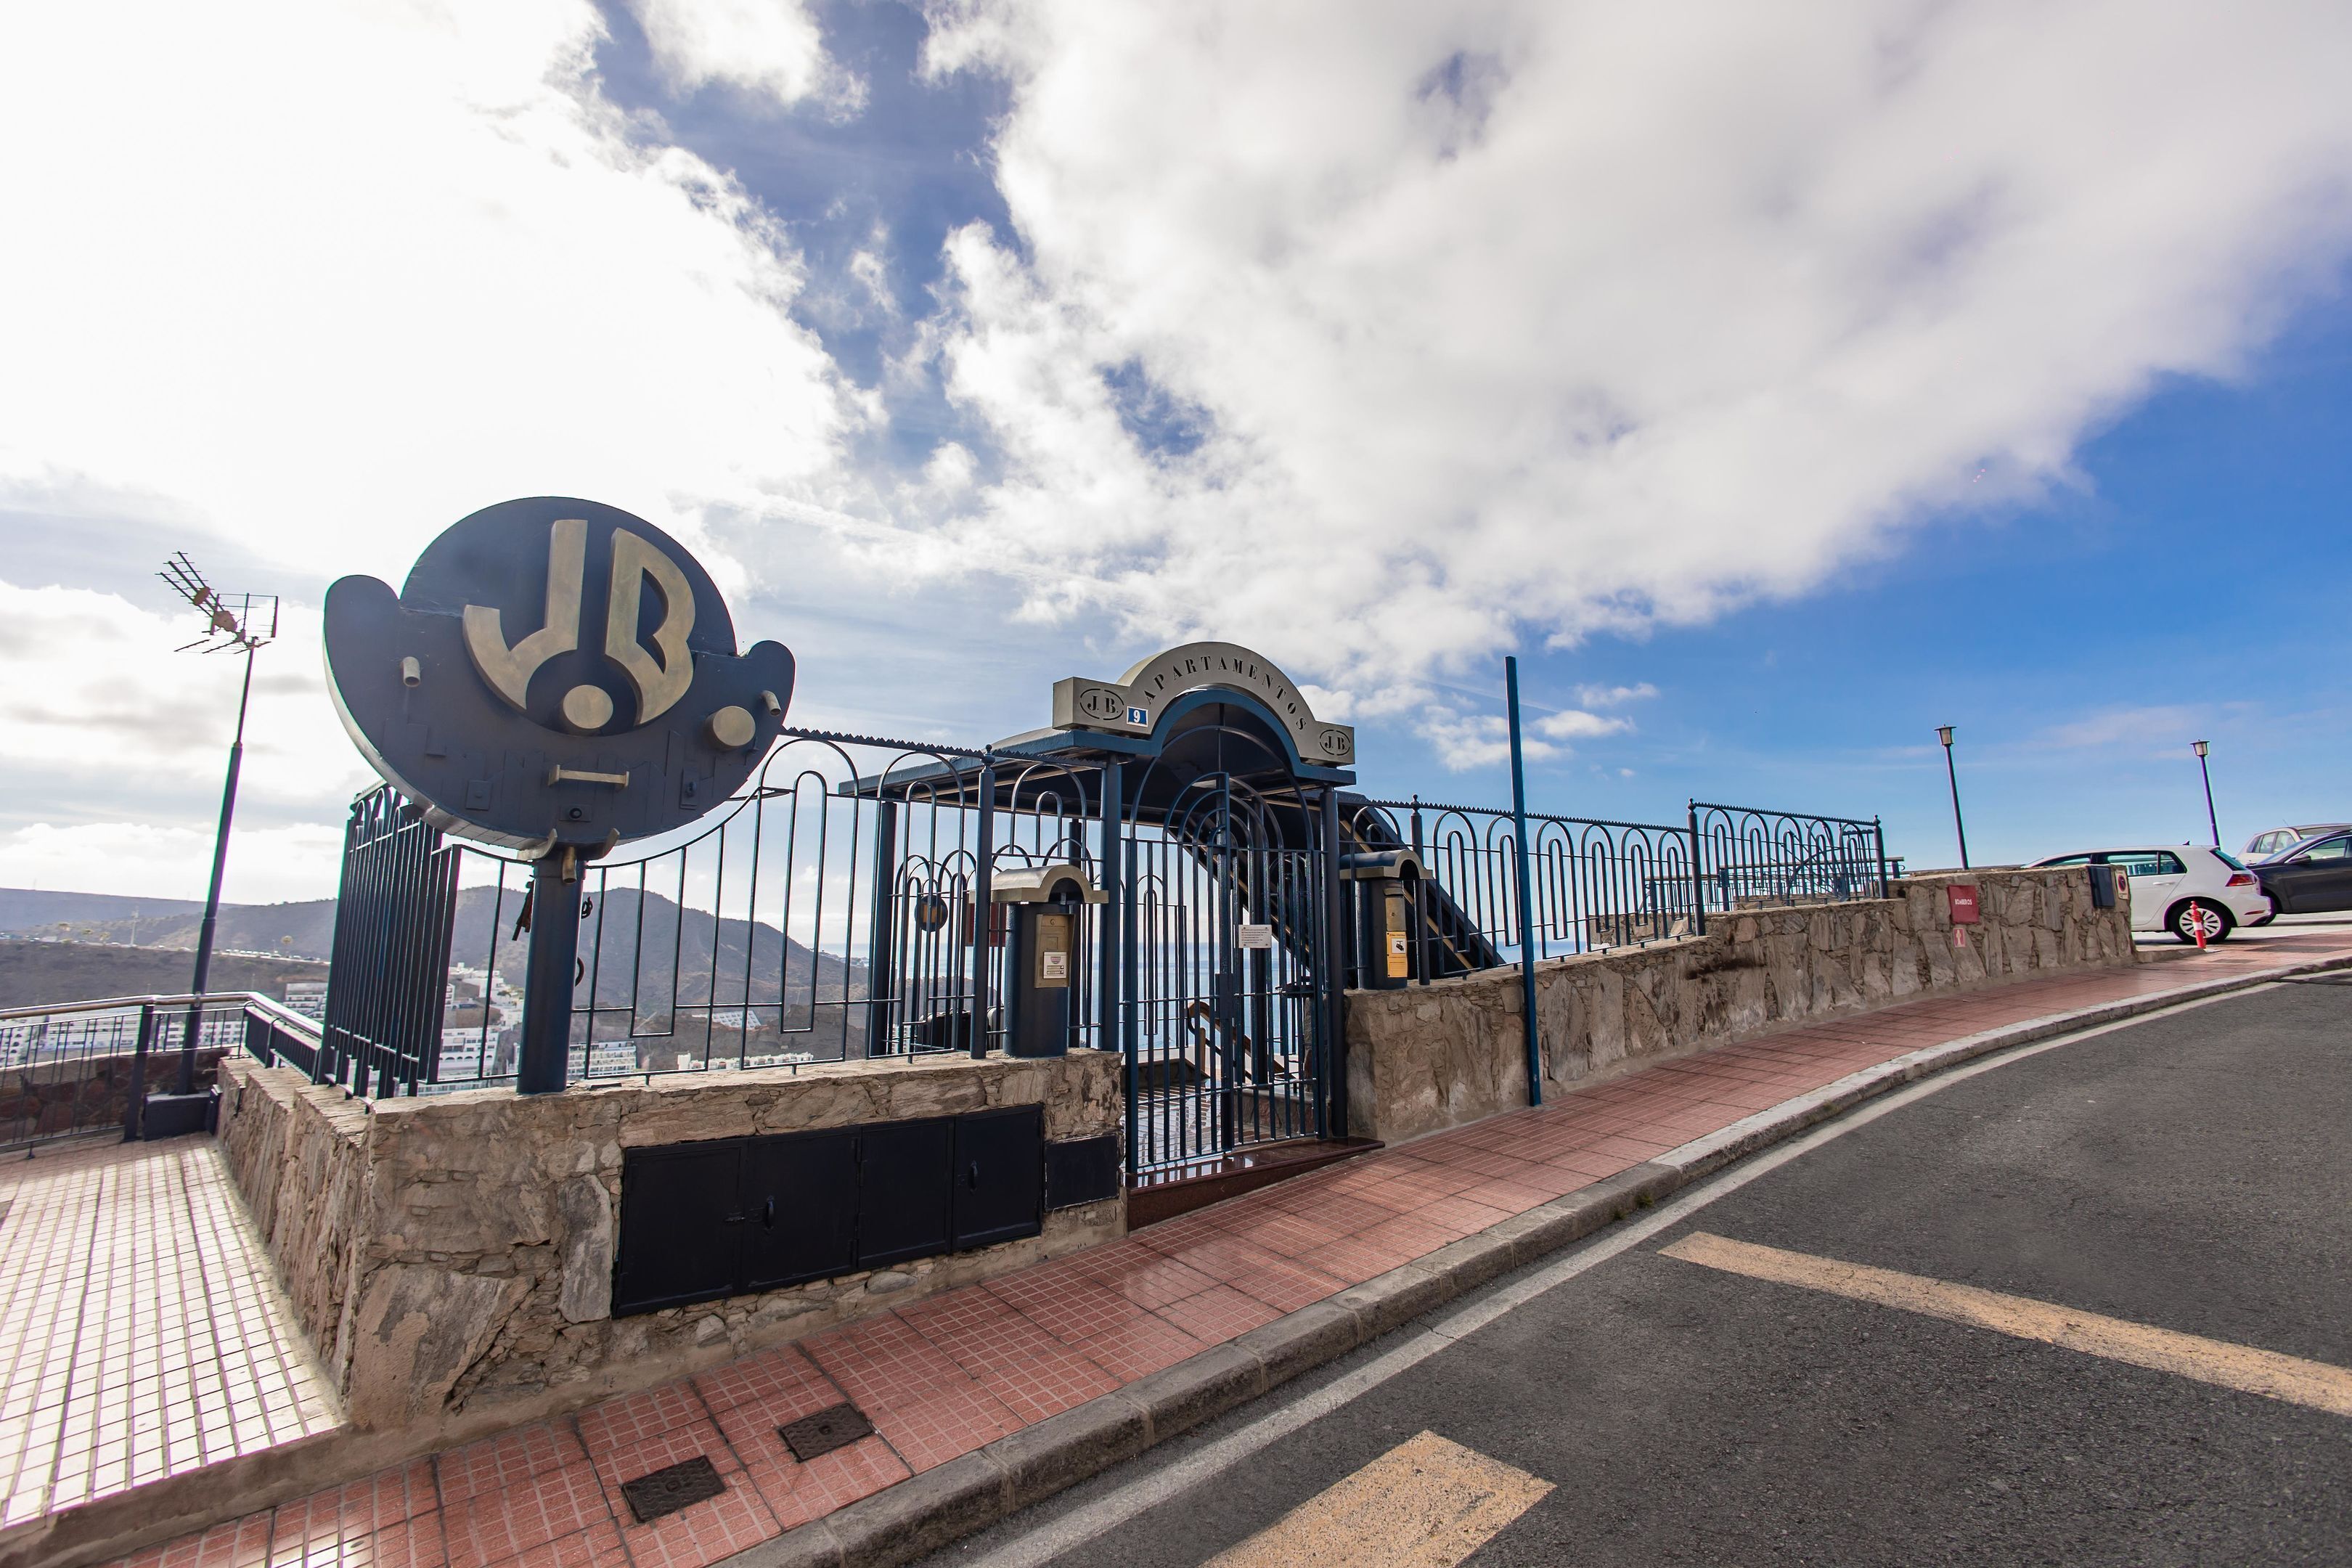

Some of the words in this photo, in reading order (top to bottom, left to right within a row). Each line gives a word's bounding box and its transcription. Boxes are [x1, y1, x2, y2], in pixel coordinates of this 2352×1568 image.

[462, 519, 695, 726] JB
[1133, 710, 1140, 723] 9
[1143, 656, 1307, 730] APARTAMENTOS
